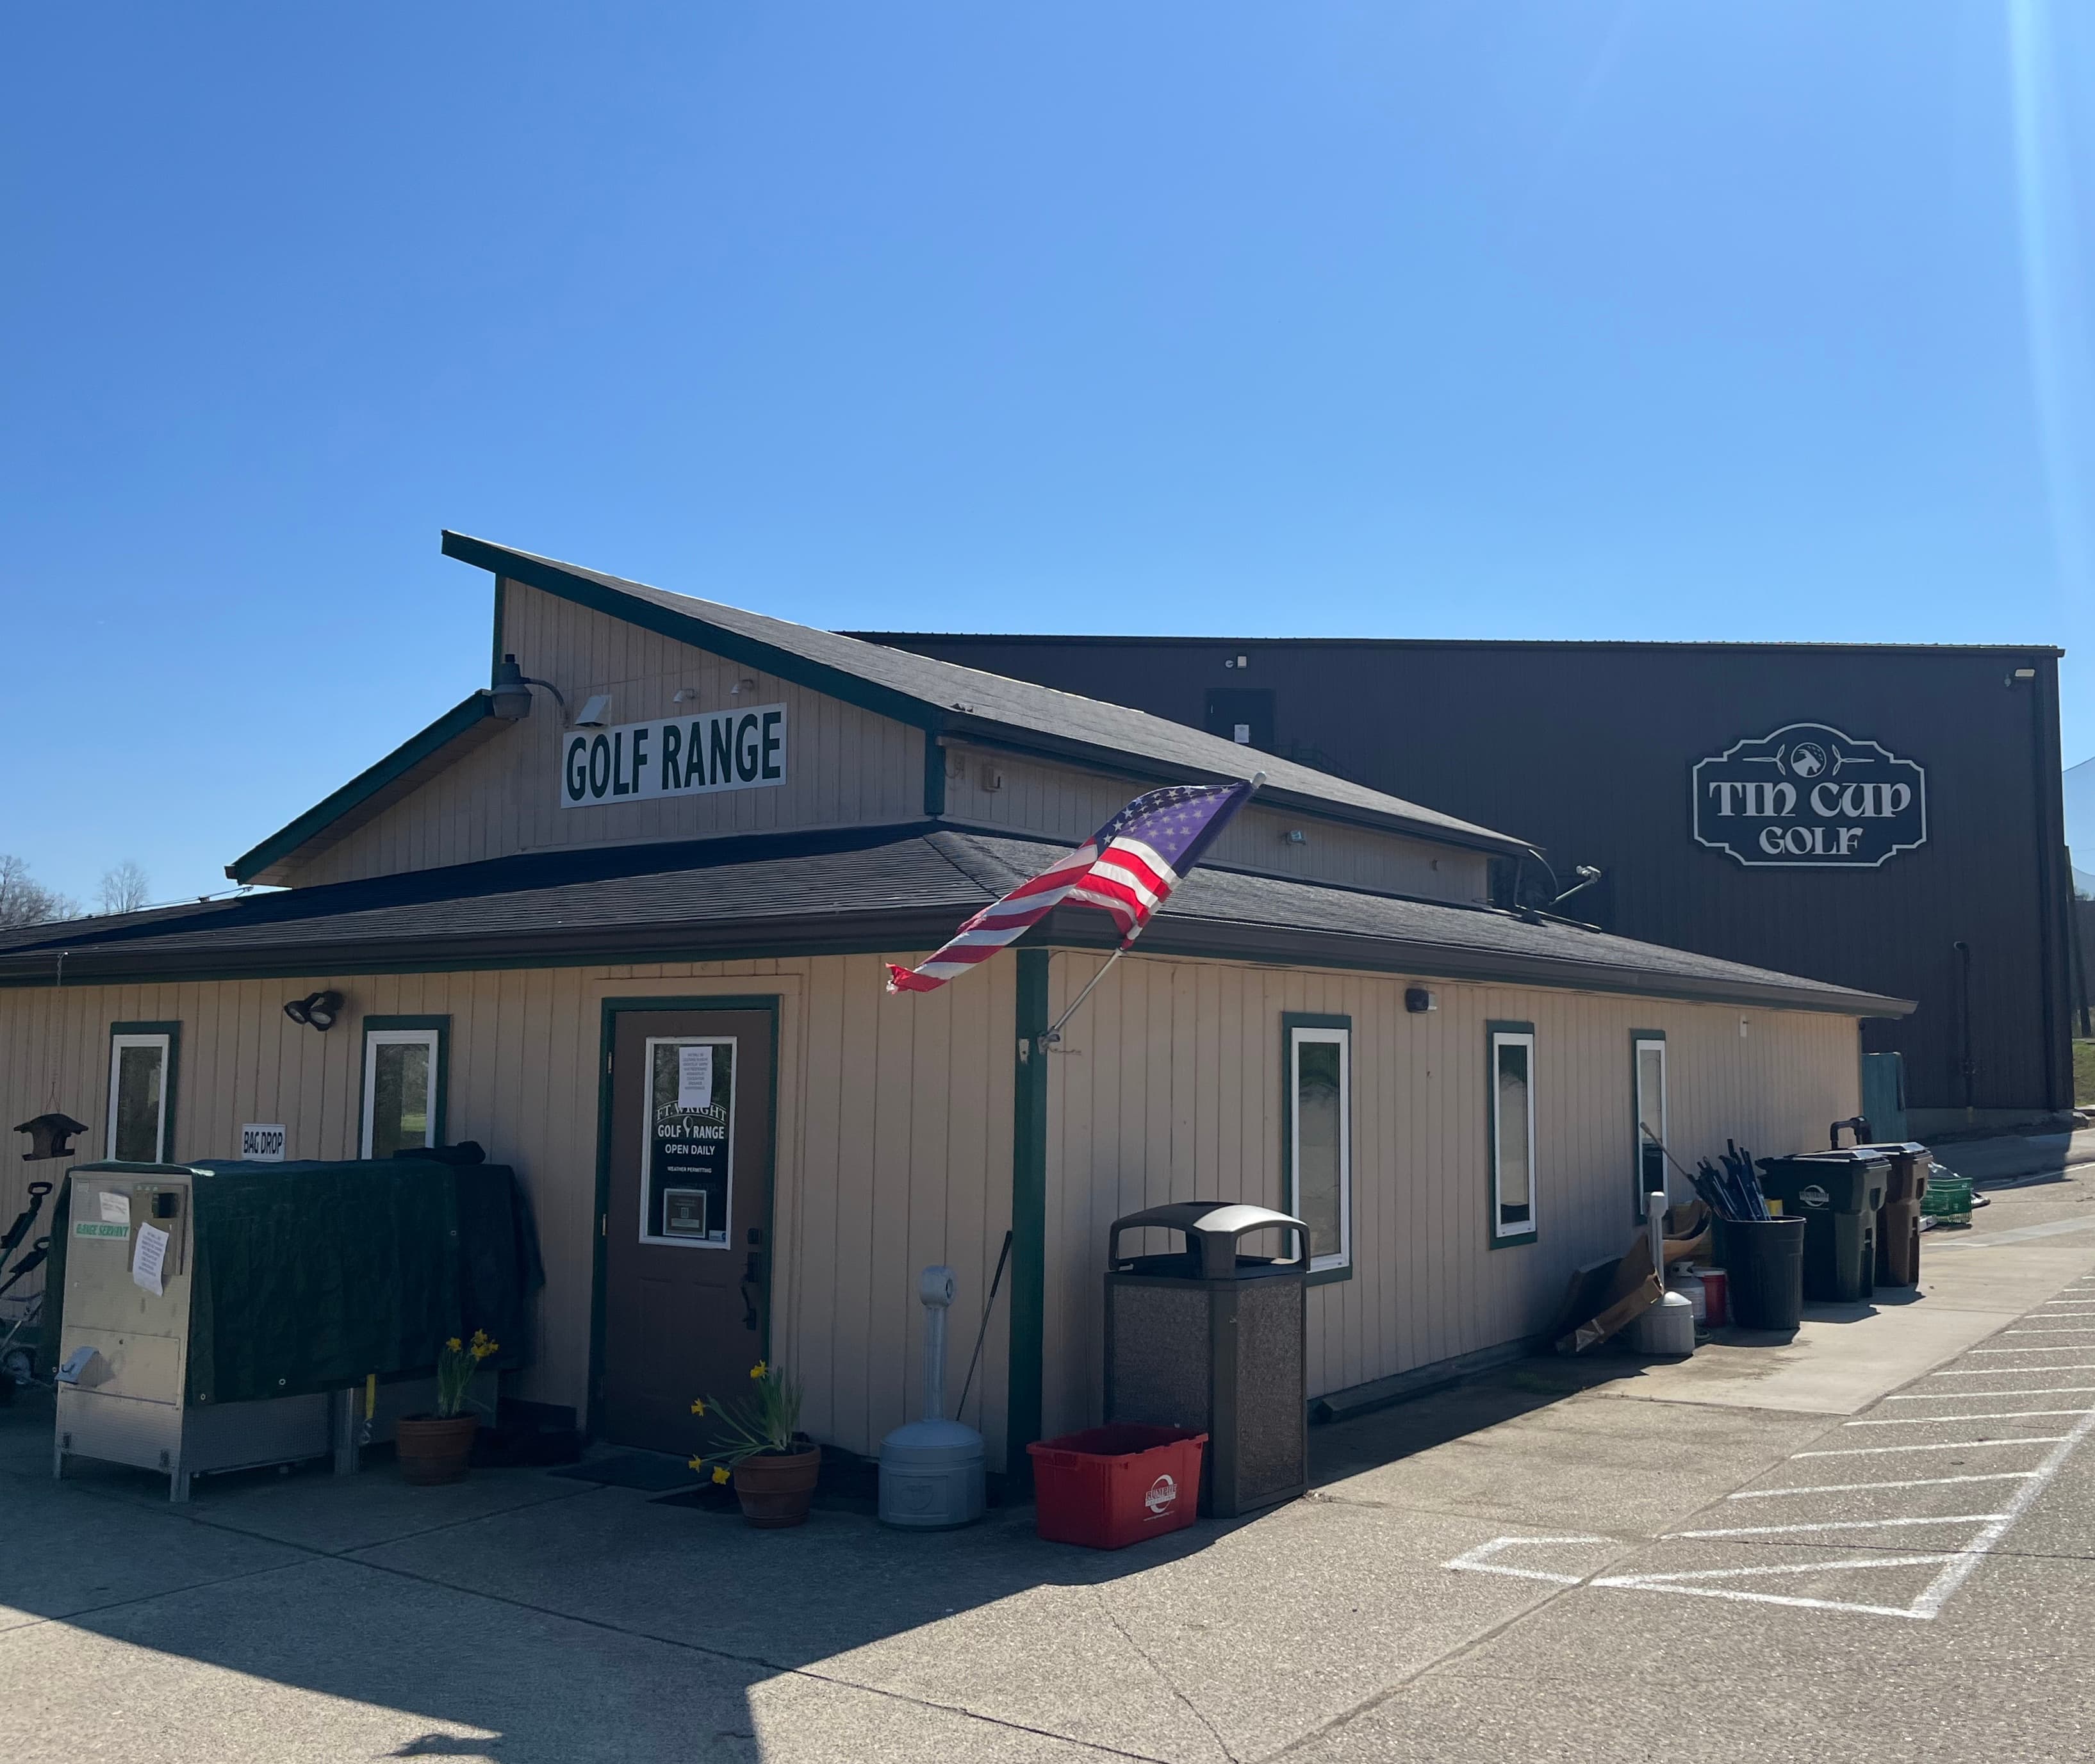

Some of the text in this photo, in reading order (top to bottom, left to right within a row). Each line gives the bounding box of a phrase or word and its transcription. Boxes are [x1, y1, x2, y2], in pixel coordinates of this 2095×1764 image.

[566, 711, 782, 801] GOLF RANGE
[1709, 782, 1911, 818] TIN CUP
[1759, 826, 1864, 855] GOLF
[657, 1104, 673, 1121] FT.
[243, 1131, 283, 1155] BAG DROP
[657, 1125, 725, 1139] GOLF RANGE
[665, 1144, 715, 1155] OPEN DAILY
